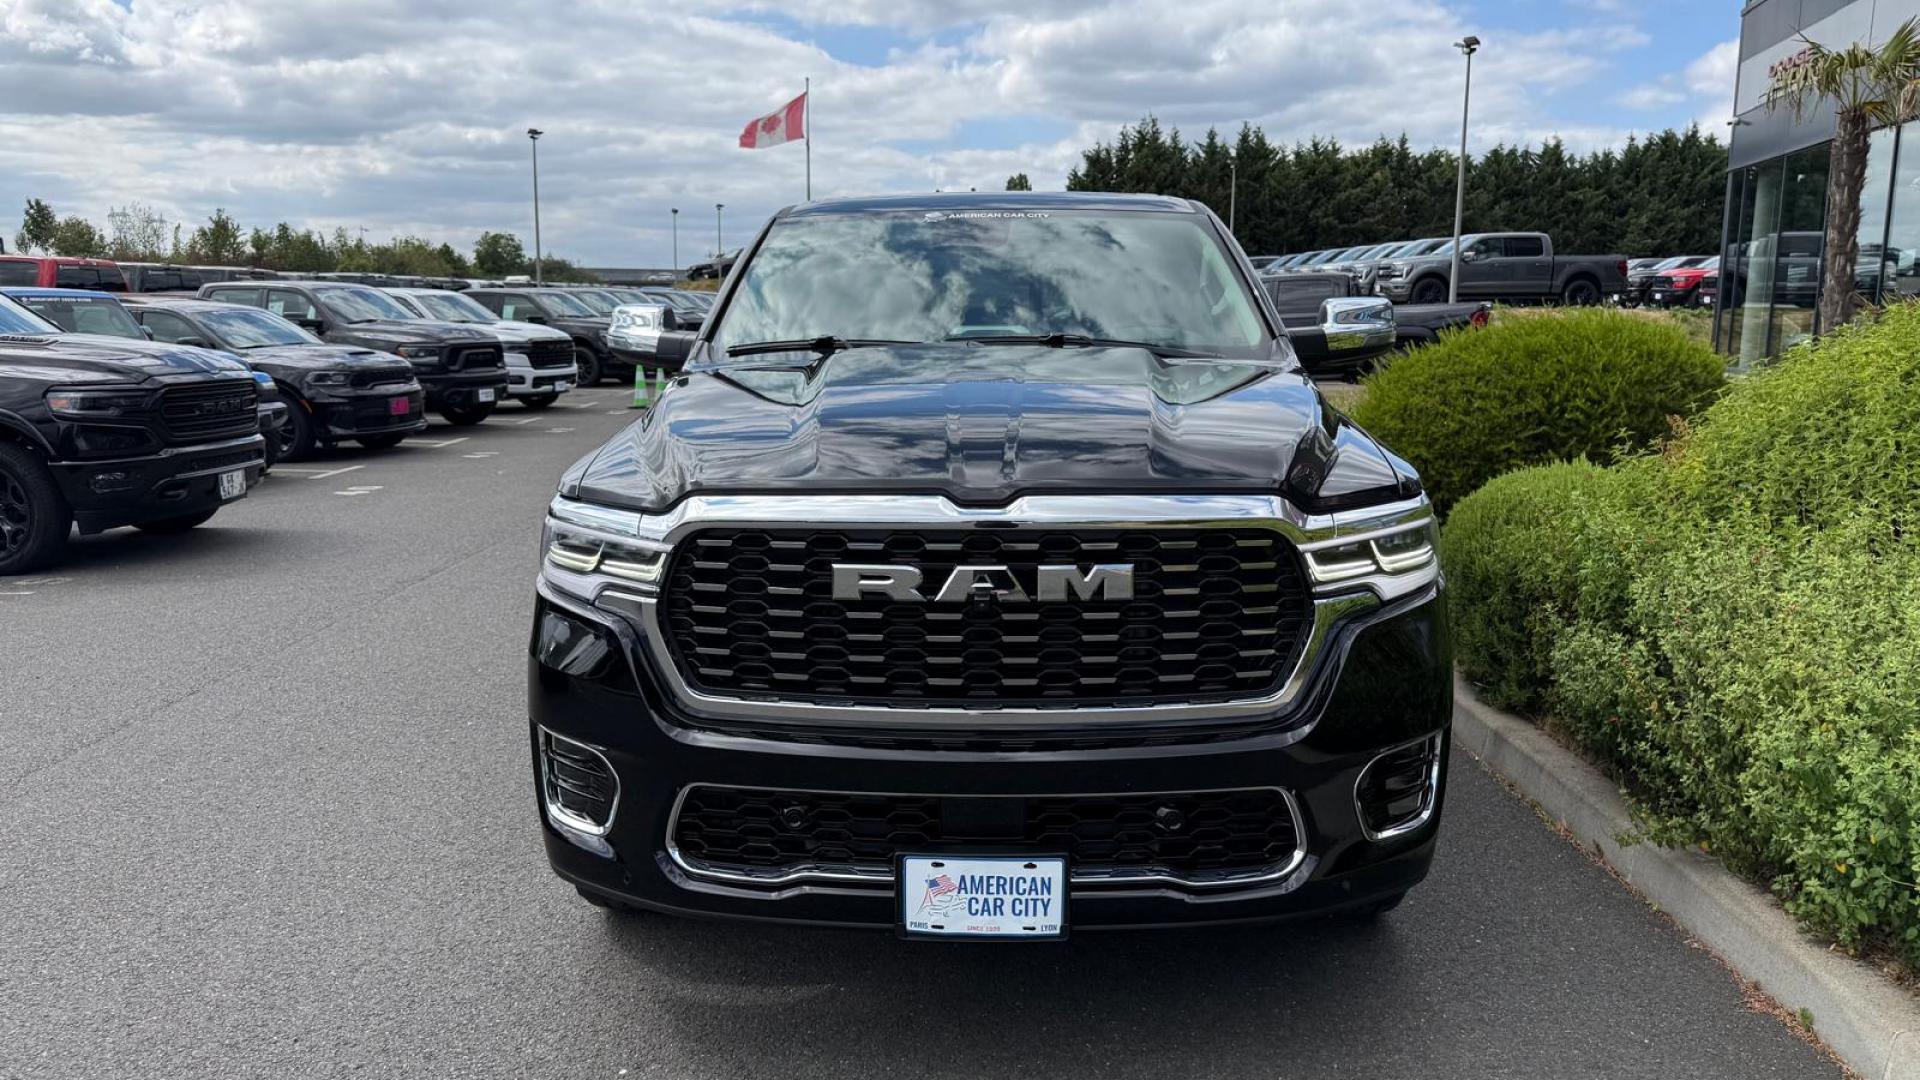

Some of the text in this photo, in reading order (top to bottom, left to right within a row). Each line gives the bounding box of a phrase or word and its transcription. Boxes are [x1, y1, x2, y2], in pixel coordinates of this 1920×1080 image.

[831, 563, 1135, 601] RAM
[957, 874, 1052, 896] AMERICAN
[967, 896, 1051, 917] CAR CITY
[1040, 923, 1058, 932] LYON
